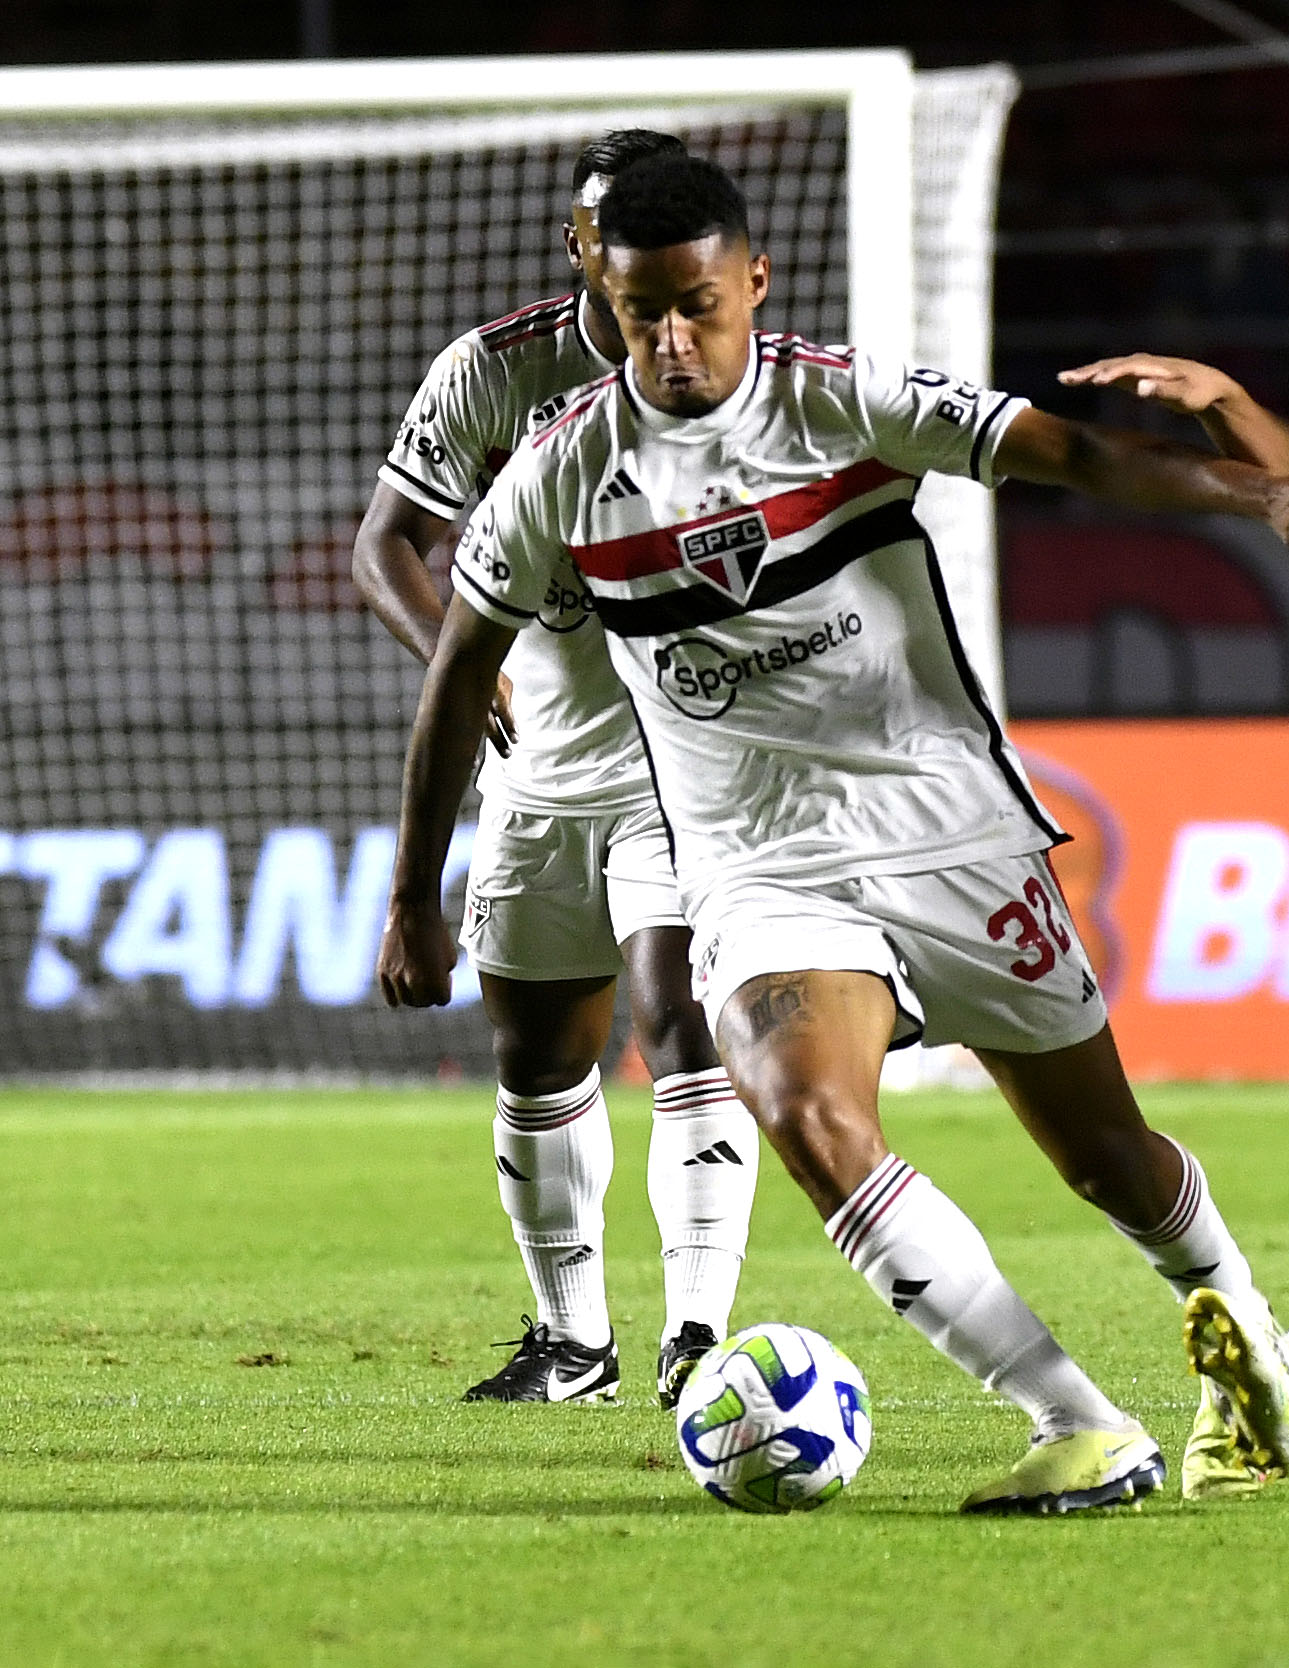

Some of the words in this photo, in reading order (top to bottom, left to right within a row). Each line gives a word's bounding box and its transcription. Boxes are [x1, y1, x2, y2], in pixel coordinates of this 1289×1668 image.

[685, 520, 762, 557] SPFC
[674, 611, 863, 700] Sportsbet.io
[986, 875, 1072, 983] 32
